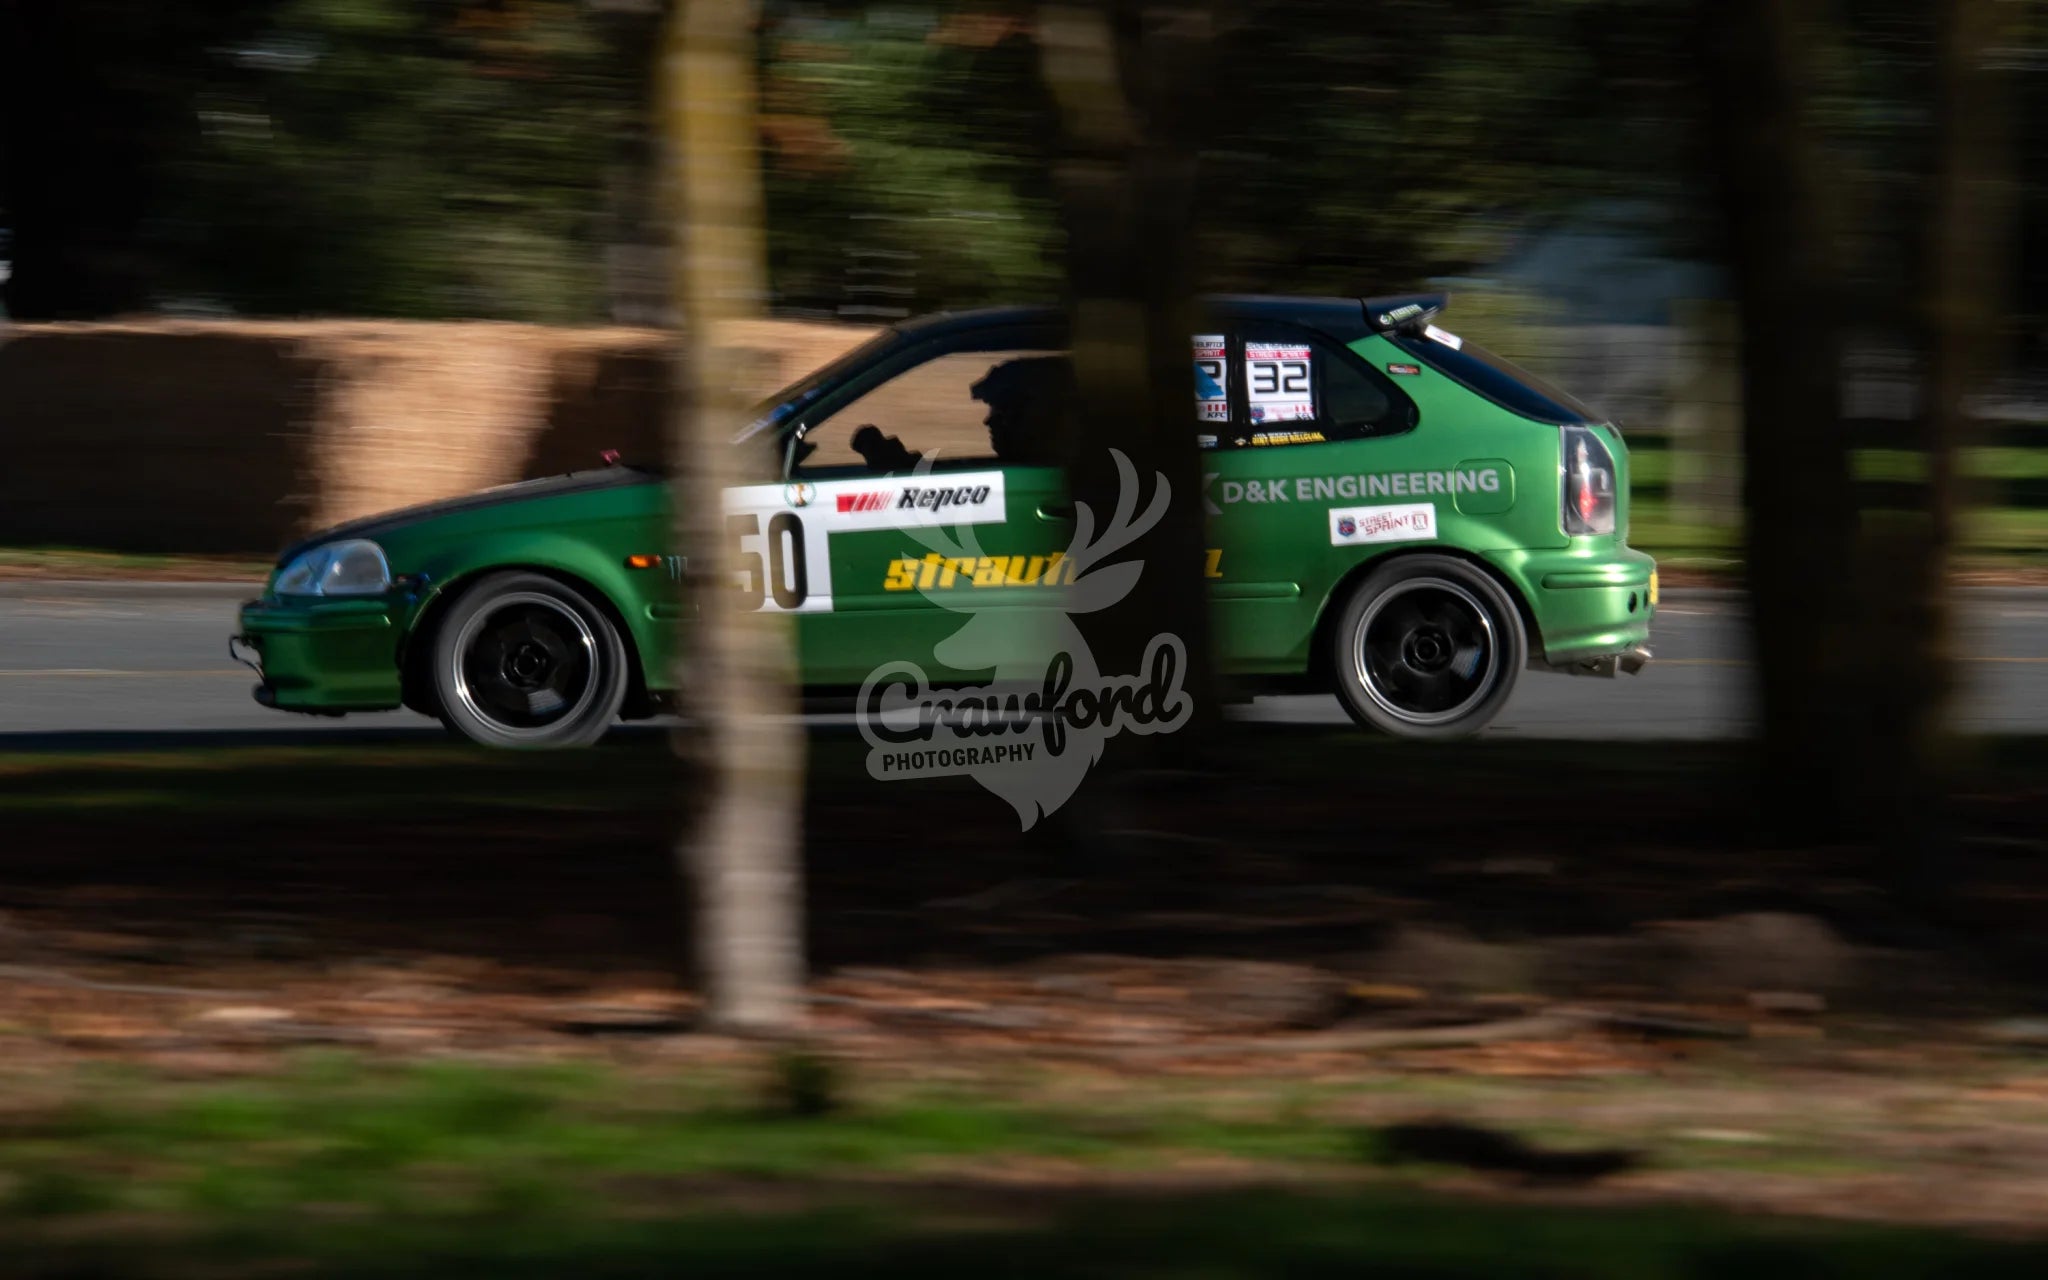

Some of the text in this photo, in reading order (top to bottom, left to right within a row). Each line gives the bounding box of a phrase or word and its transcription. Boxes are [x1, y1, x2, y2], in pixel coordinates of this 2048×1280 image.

[1253, 361, 1308, 394] 32
[1207, 411, 1226, 419] KFC
[896, 484, 991, 513] Repco
[1224, 469, 1500, 504] D&K ENGINEERING
[1358, 511, 1393, 528] STREET
[1365, 514, 1410, 536] SPRINT
[724, 510, 808, 615] 50
